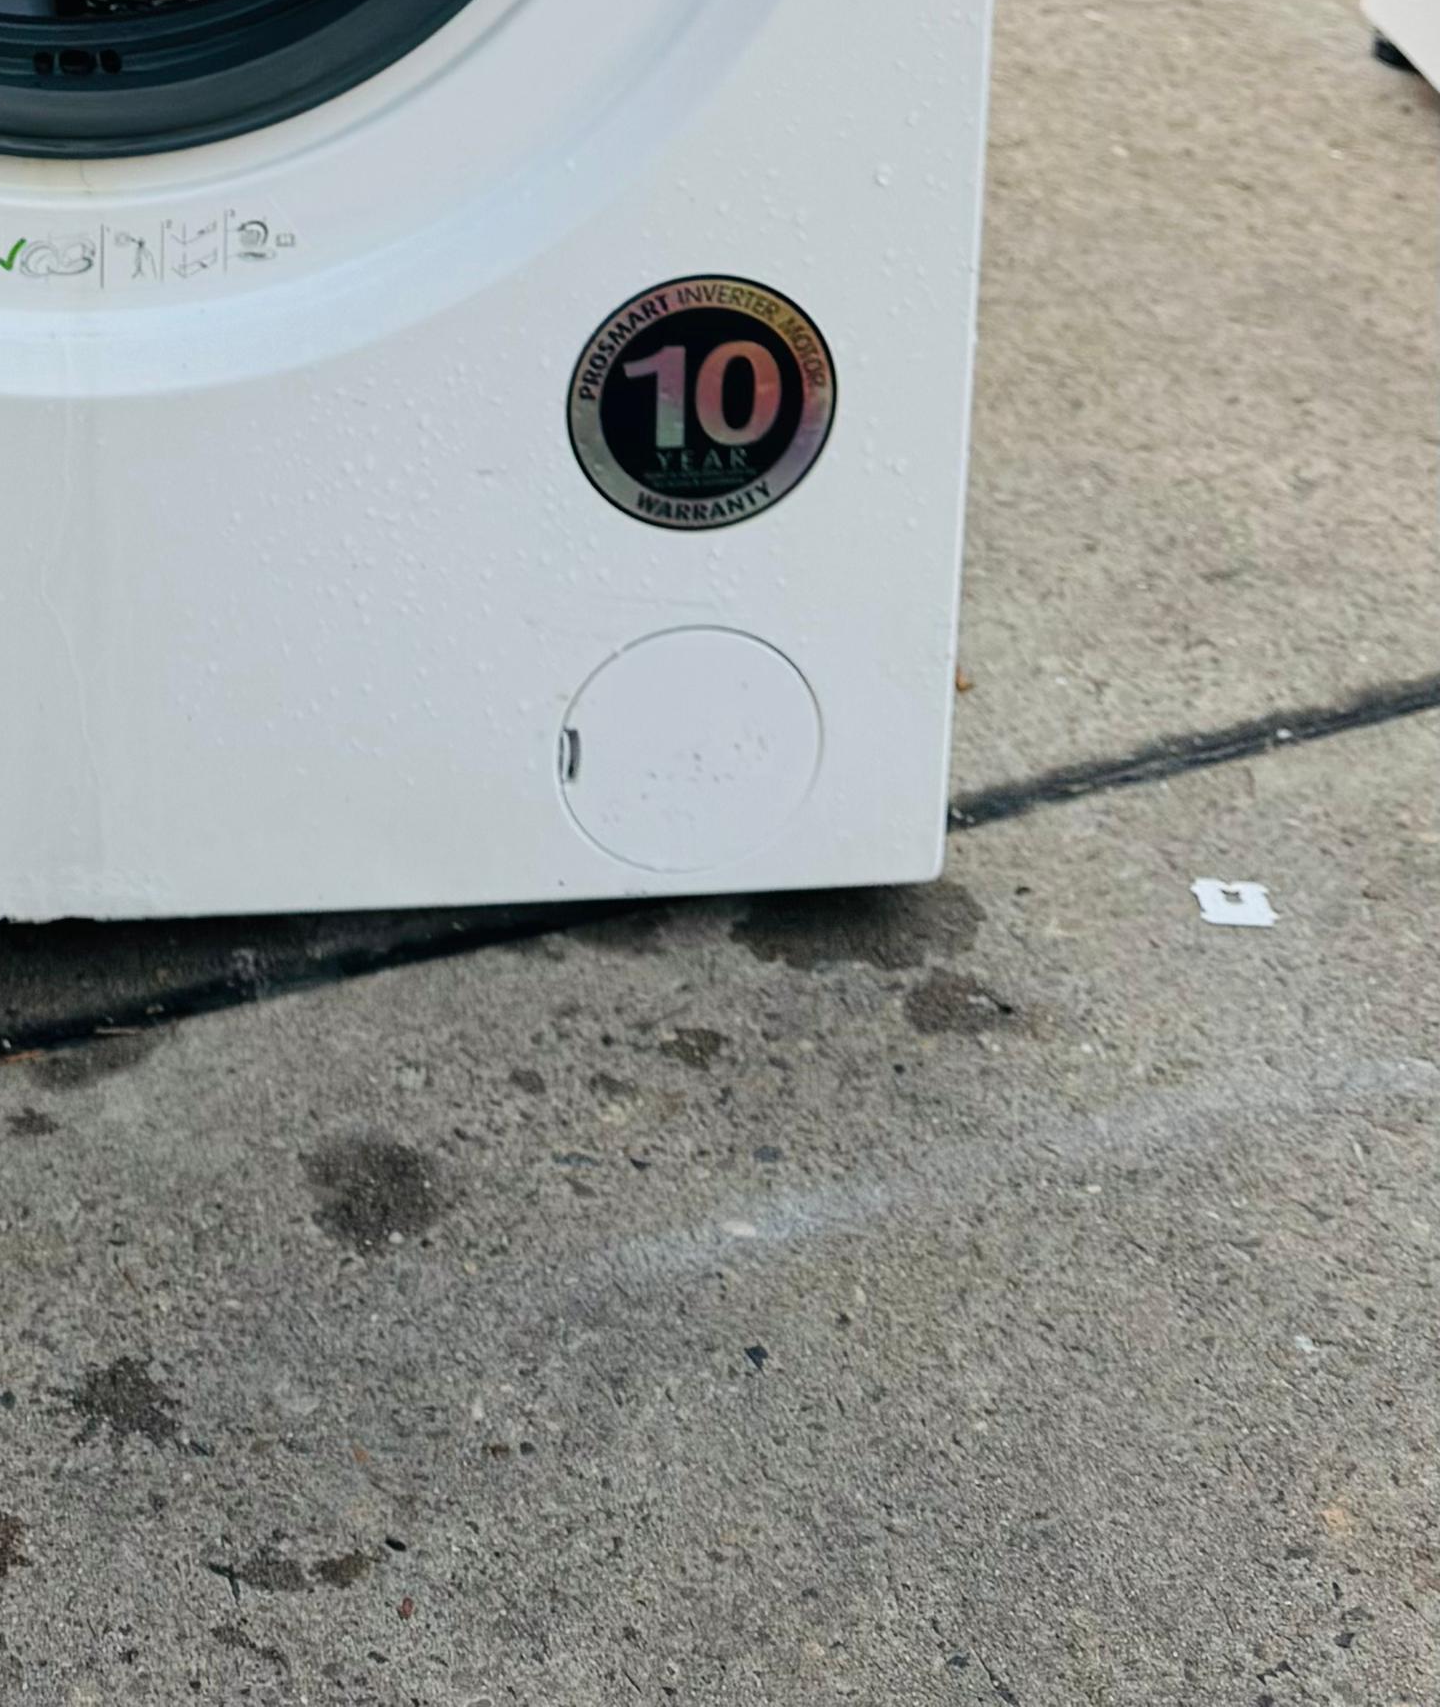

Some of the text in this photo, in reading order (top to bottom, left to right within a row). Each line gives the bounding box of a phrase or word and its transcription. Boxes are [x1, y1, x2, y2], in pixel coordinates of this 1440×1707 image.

[579, 284, 826, 401] PROSMART INVERTER MOTOR
[623, 340, 782, 448] 10
[656, 447, 748, 472] YEAR
[635, 481, 773, 522] WARRANTY
